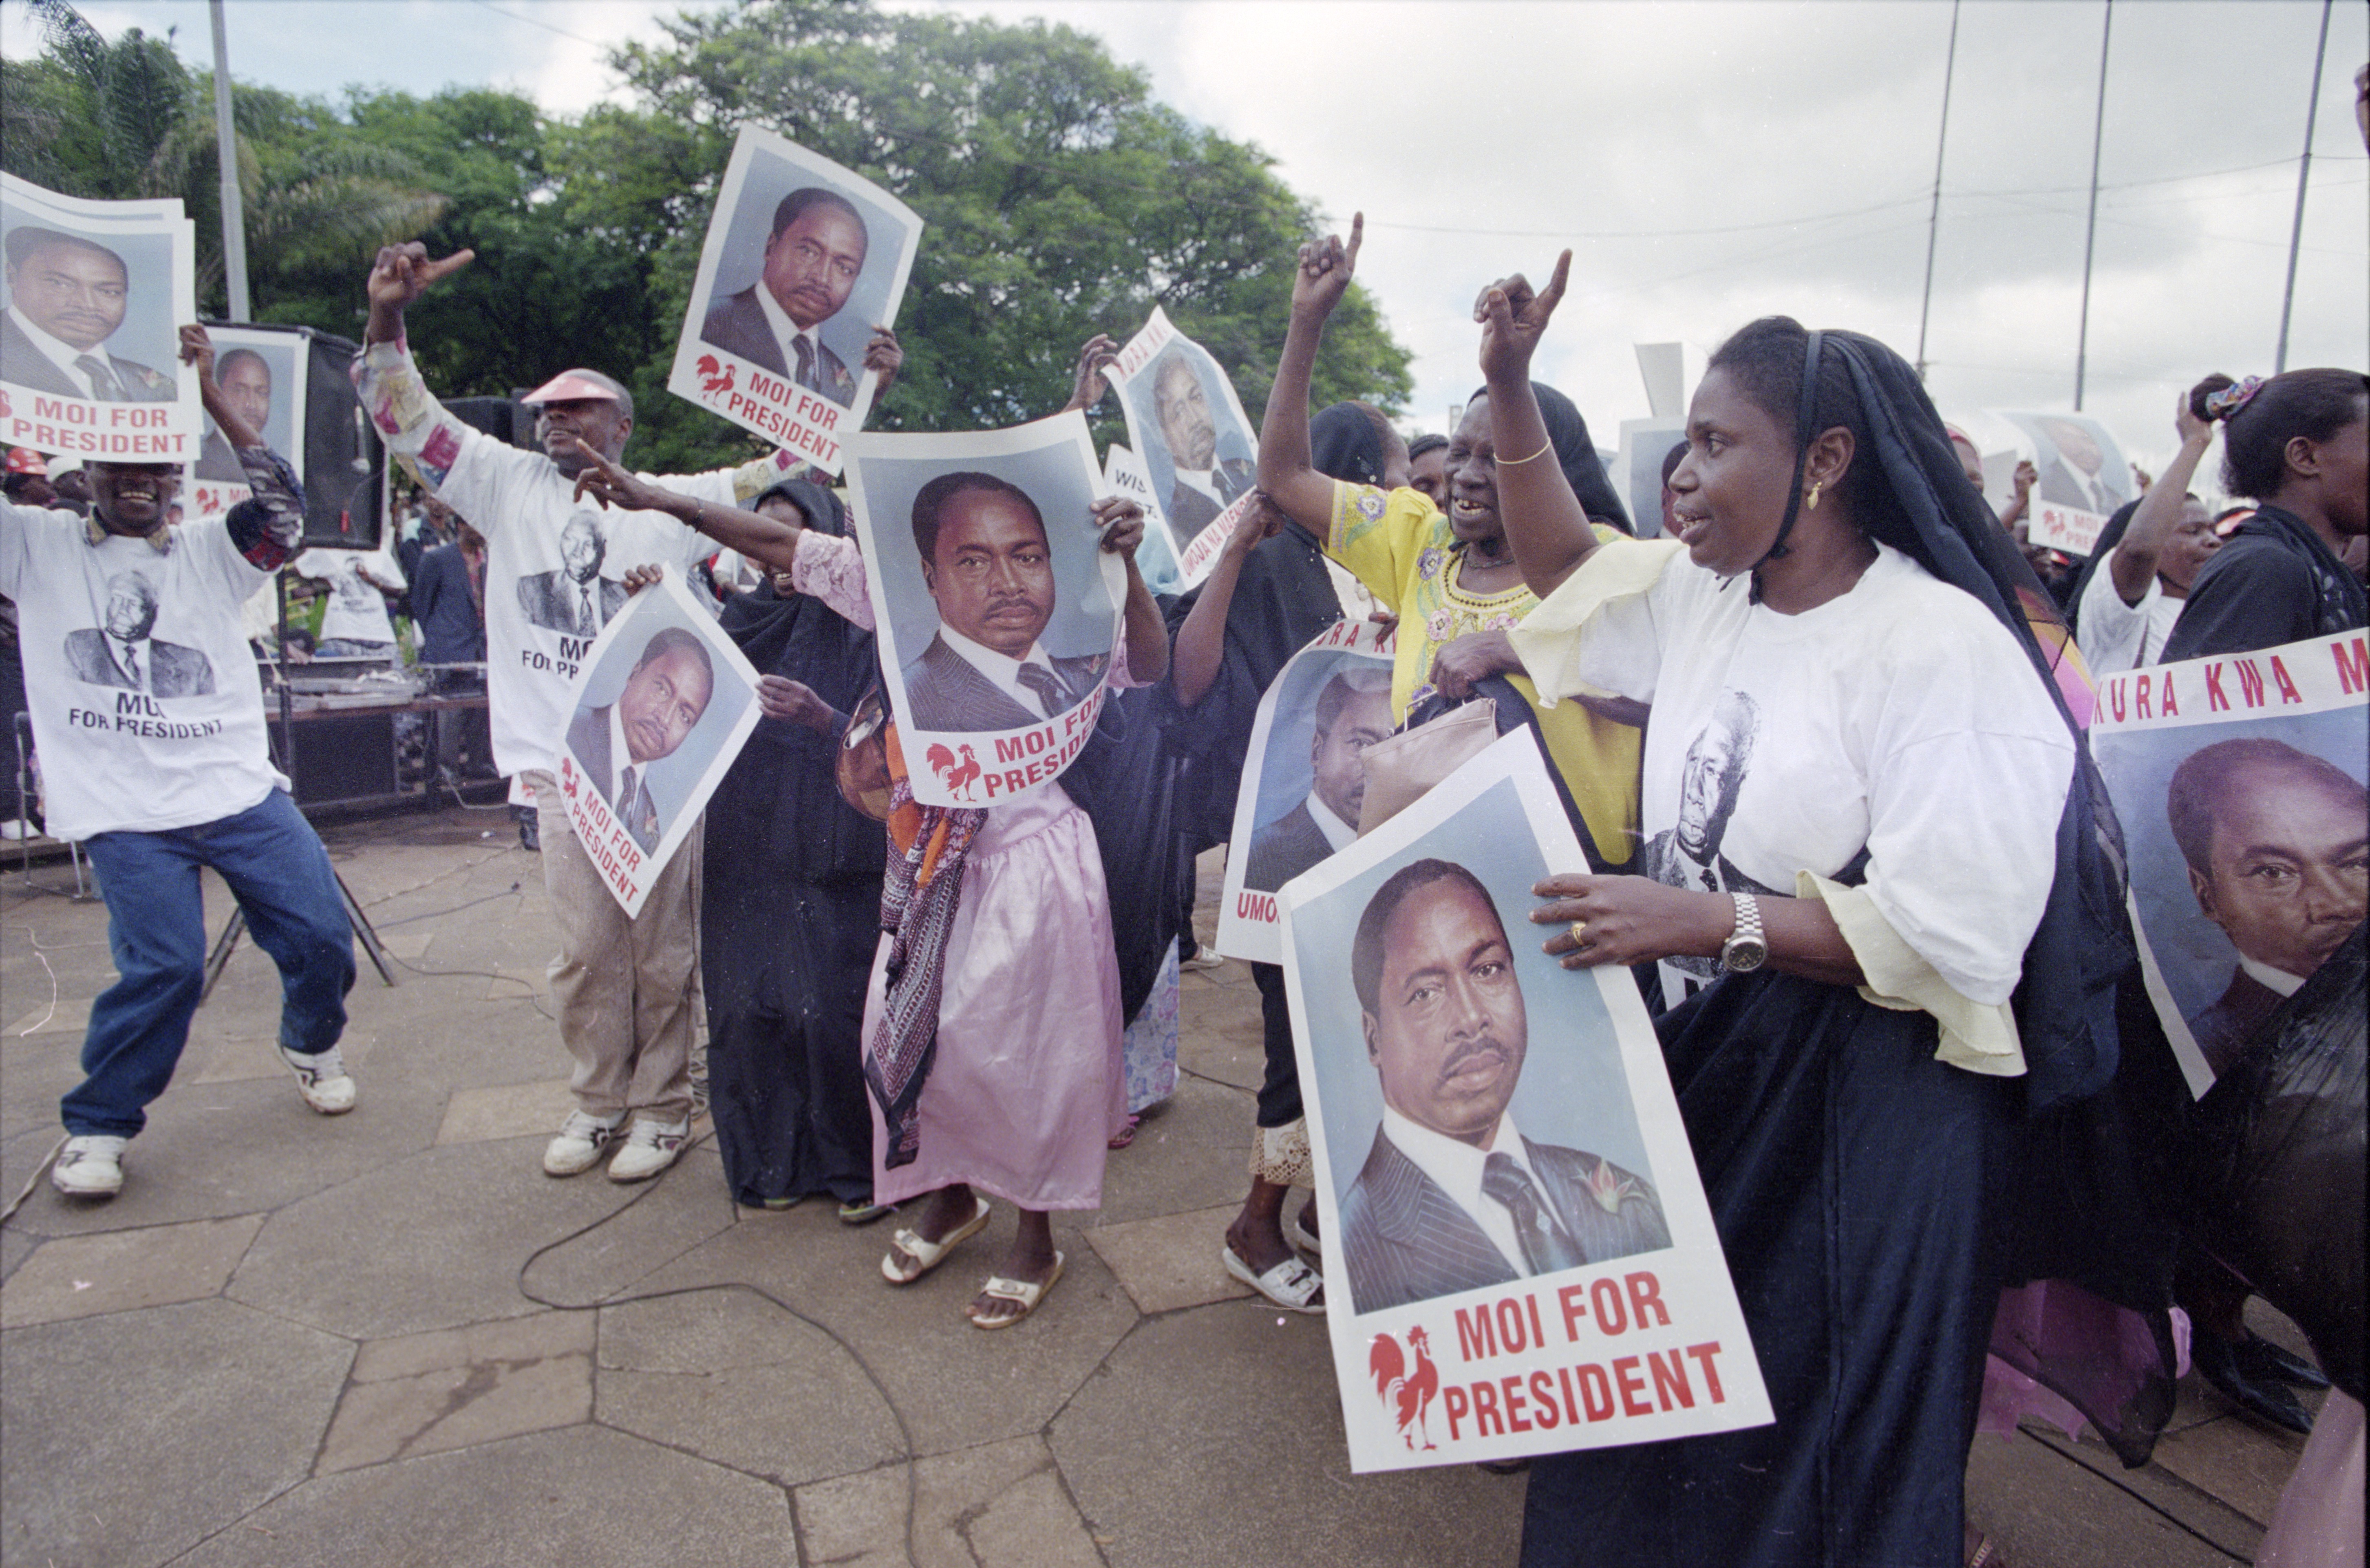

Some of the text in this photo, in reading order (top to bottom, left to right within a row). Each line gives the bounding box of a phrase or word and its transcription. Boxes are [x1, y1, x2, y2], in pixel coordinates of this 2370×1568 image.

[13, 418, 187, 453] PRESIDENT
[35, 397, 168, 427] MOI FOR
[728, 392, 840, 462] PRESIDENT
[750, 372, 838, 431] MOI FOR
[70, 708, 109, 730] FOR
[994, 685, 1102, 763] MOI FOR
[2094, 670, 2179, 724] KURA
[2205, 655, 2303, 712] KWA
[983, 705, 1100, 798] PRESIDEN
[572, 802, 638, 902] PRESIDENT
[585, 791, 641, 873] MOI FOR
[1237, 892, 1280, 924] UMO
[1454, 1270, 1672, 1362] MOI FOR
[1443, 1341, 1726, 1441] PRESIDENT
